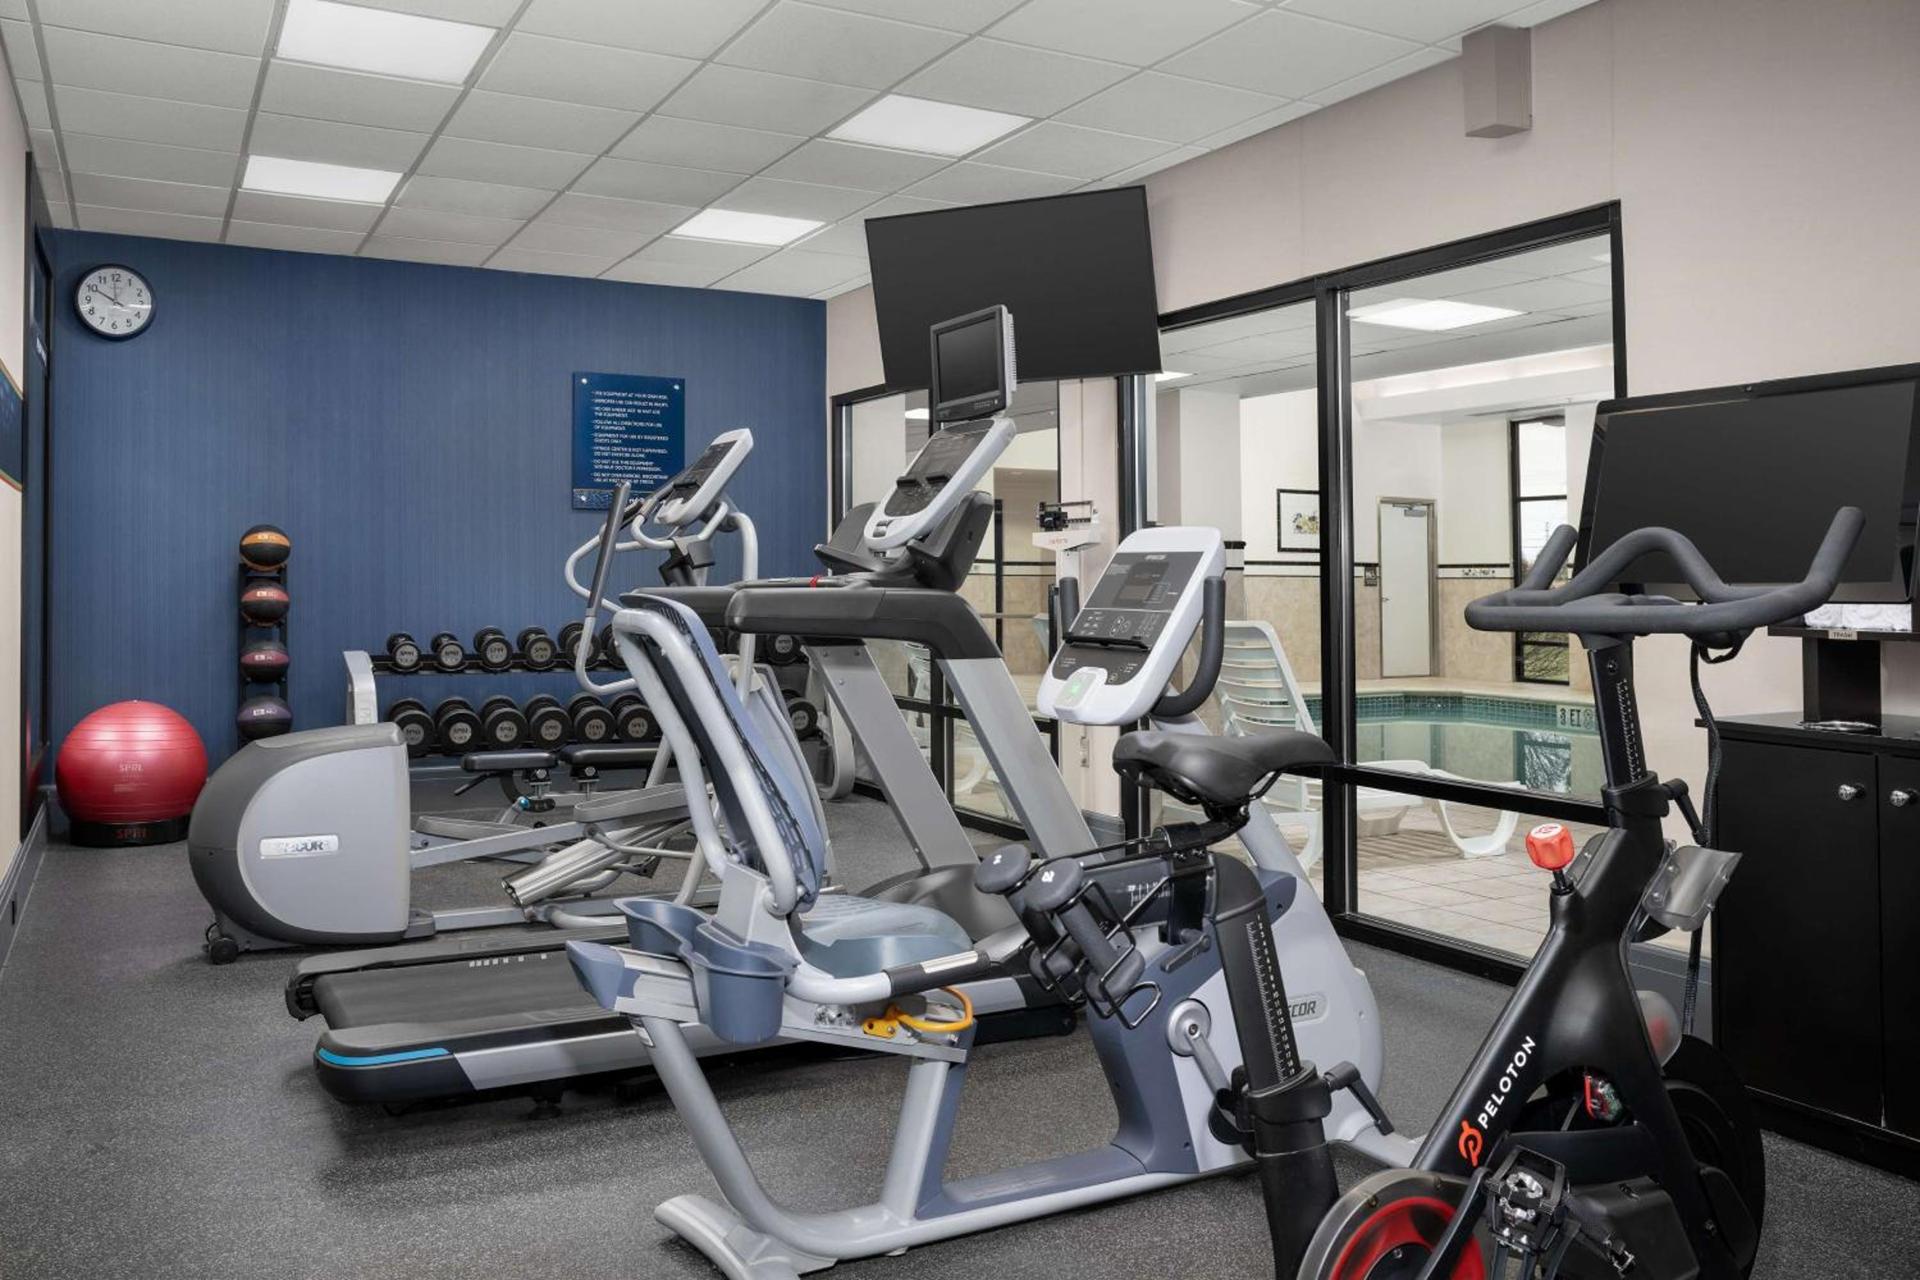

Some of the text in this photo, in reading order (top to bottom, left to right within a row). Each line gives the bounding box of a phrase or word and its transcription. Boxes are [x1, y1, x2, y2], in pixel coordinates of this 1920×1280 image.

[111, 274, 121, 282] 12
[87, 284, 98, 292] 10
[136, 288, 142, 297] 2
[85, 295, 91, 304] 9
[99, 317, 105, 325] 7
[111, 321, 117, 329] 6
[1288, 1000, 1316, 1018] COR
[1477, 1035, 1536, 1130] PELOTON
